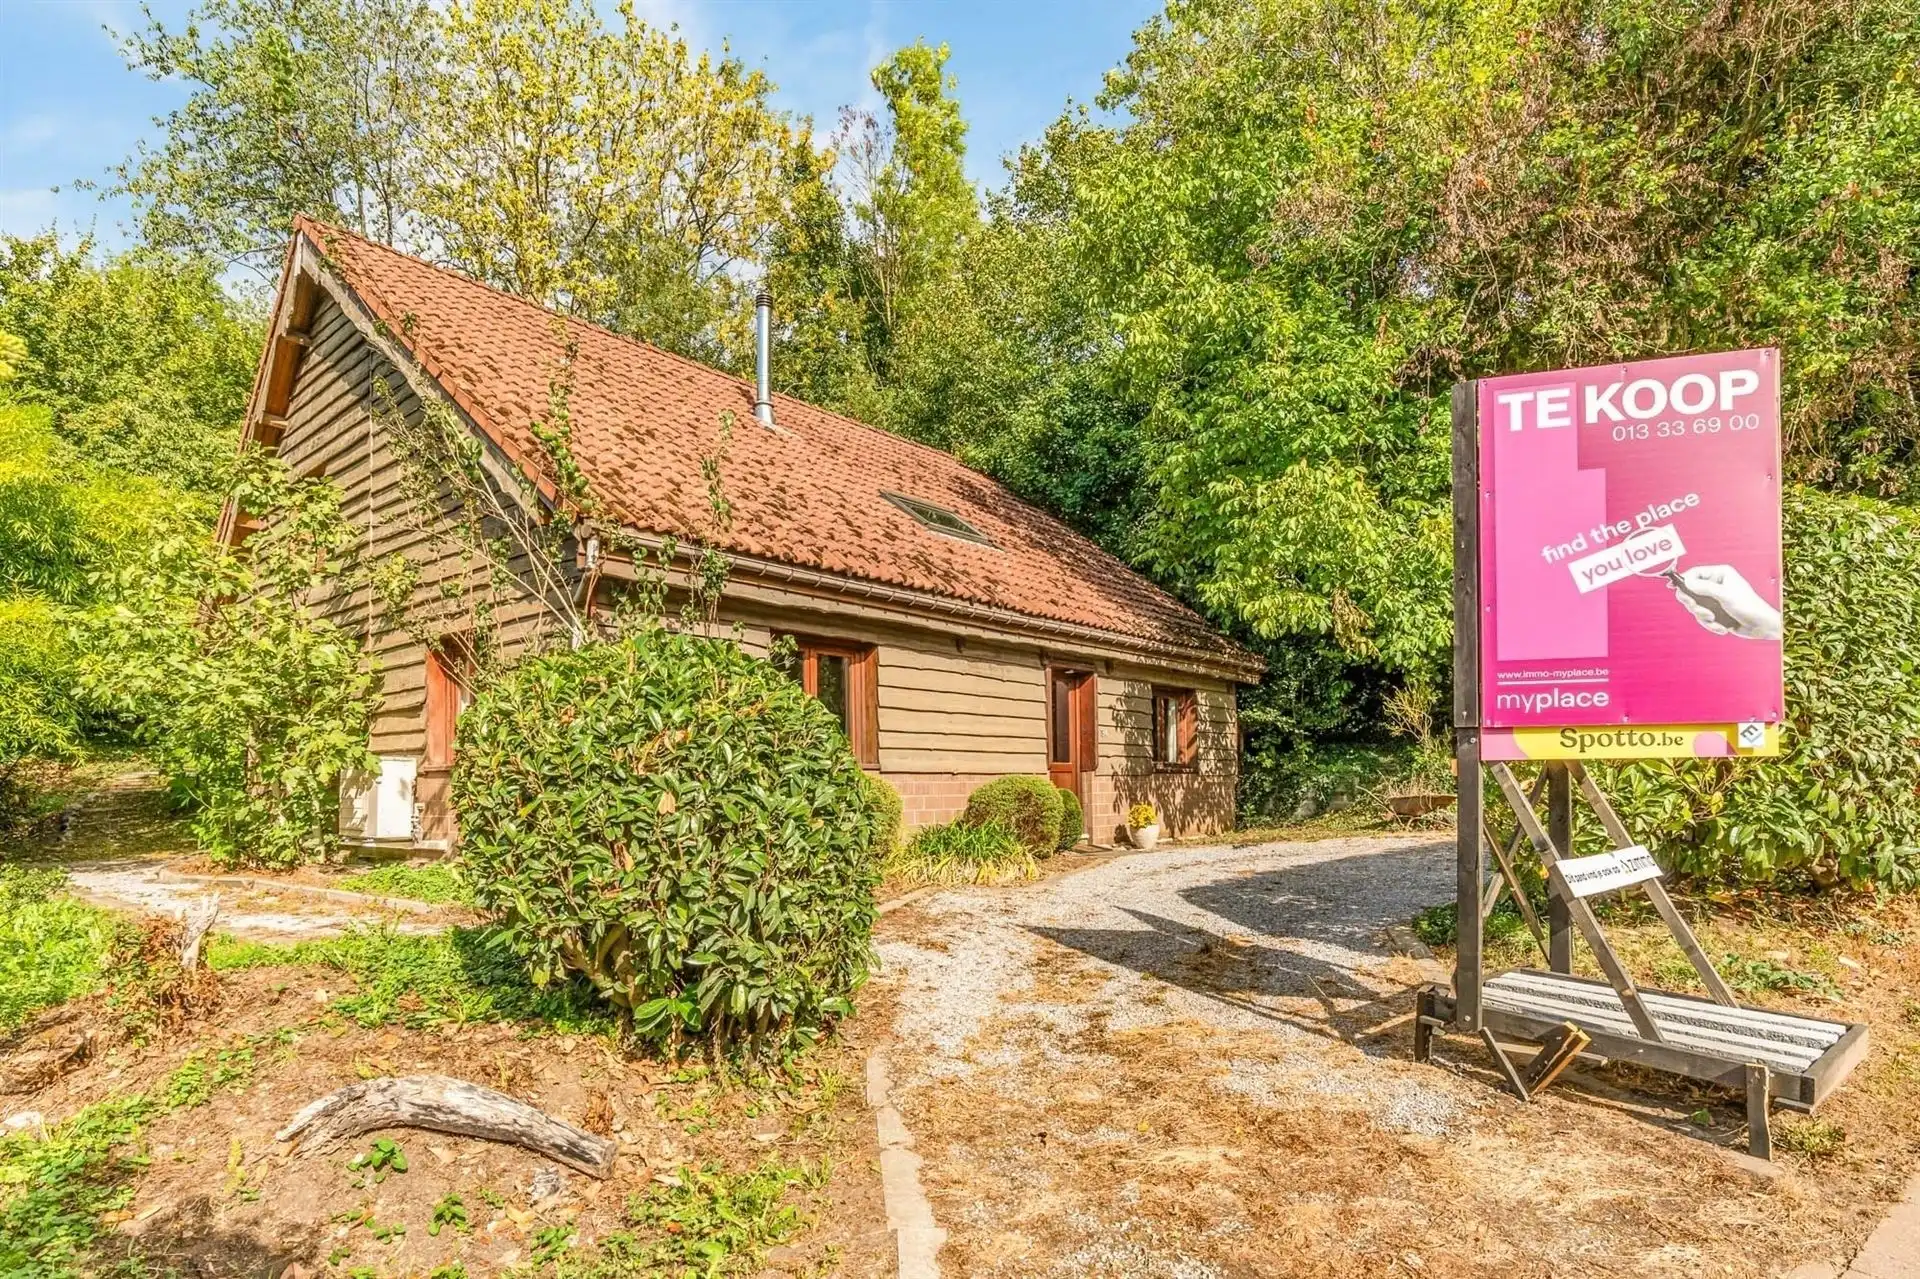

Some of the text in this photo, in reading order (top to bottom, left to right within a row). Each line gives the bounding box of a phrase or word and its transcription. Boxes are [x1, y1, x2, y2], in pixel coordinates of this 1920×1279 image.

[1497, 369, 1760, 432] TE KOOP
[1612, 413, 1760, 442] 013 33 69 00
[1541, 493, 1700, 564] find the place
[1581, 538, 1673, 585] you love
[1497, 668, 1609, 680] www.immo-myplace.be
[1497, 687, 1609, 713] myplace
[1559, 727, 1684, 753] Spotto.be
